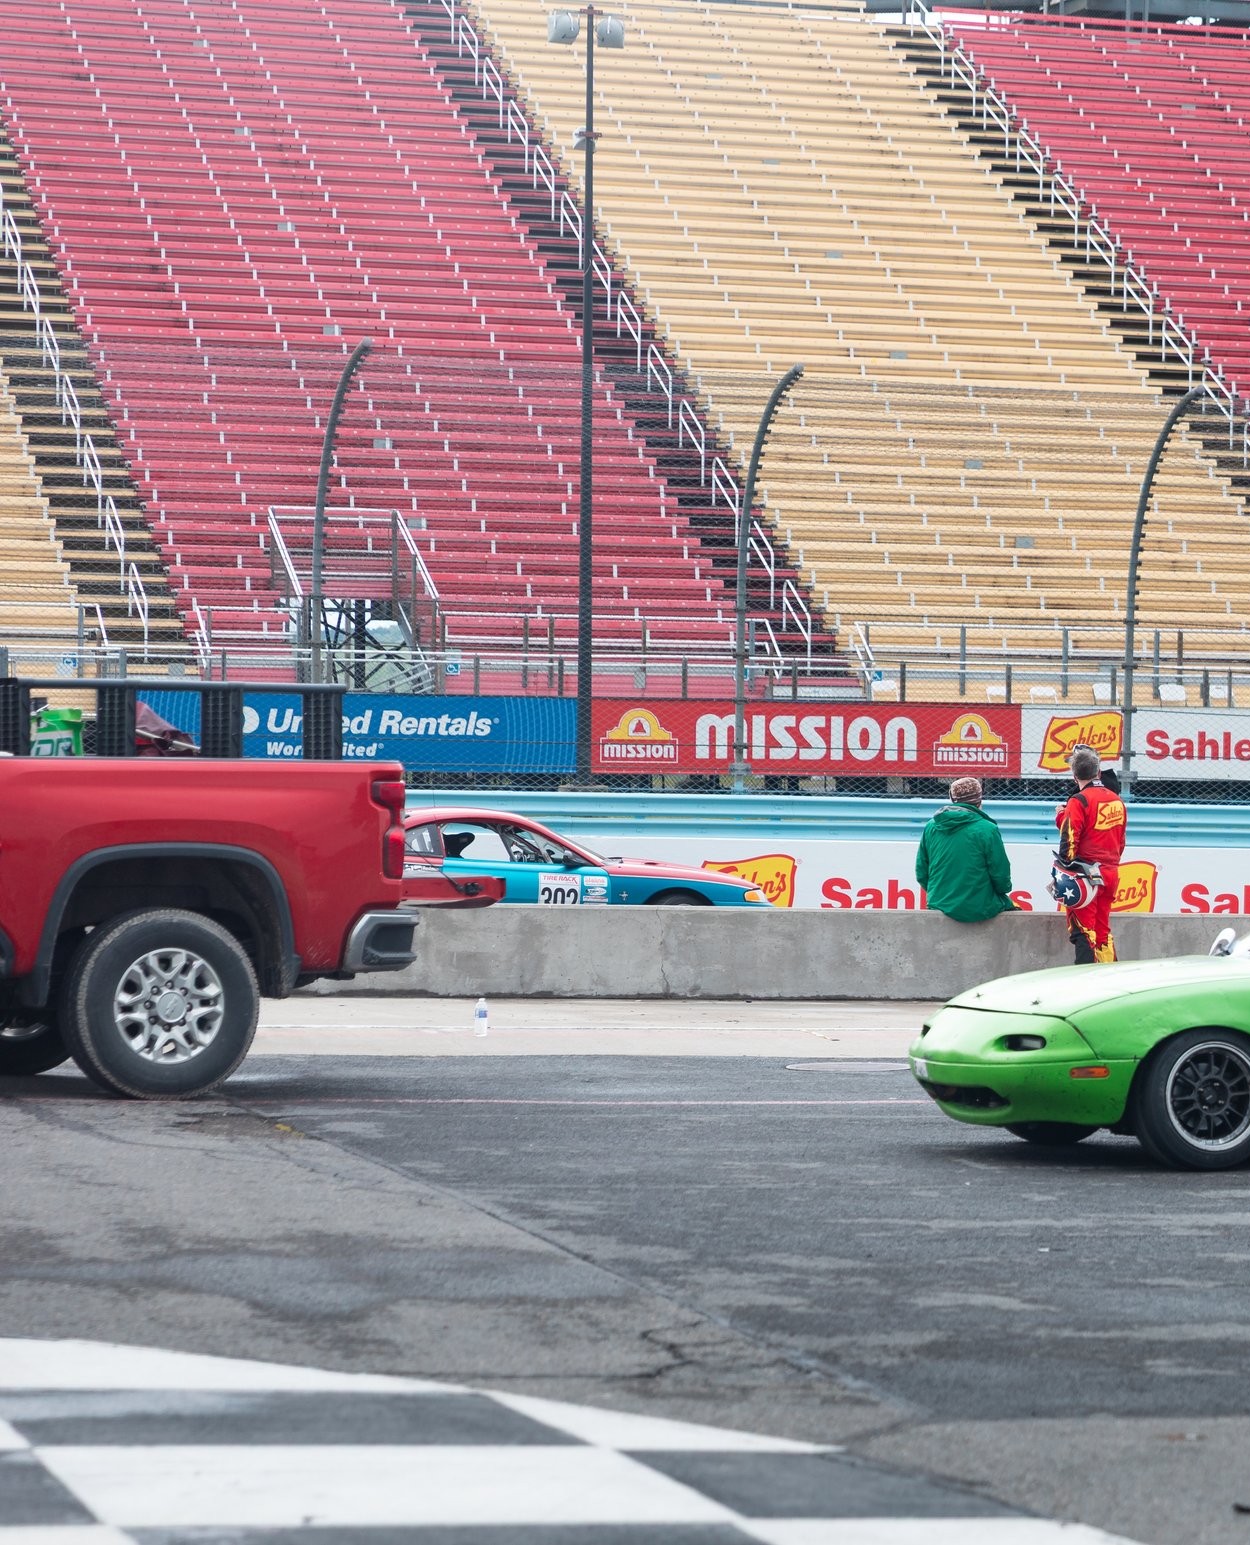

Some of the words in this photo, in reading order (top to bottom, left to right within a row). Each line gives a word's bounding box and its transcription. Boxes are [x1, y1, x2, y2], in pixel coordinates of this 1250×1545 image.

[266, 708, 373, 734] Uned
[378, 709, 492, 736] Rentals
[695, 713, 918, 762] MISSION
[266, 741, 304, 756] Wor
[342, 743, 377, 756] ited
[603, 743, 675, 759] MISSION
[936, 746, 1005, 763] MISSION
[559, 875, 578, 884] RACK
